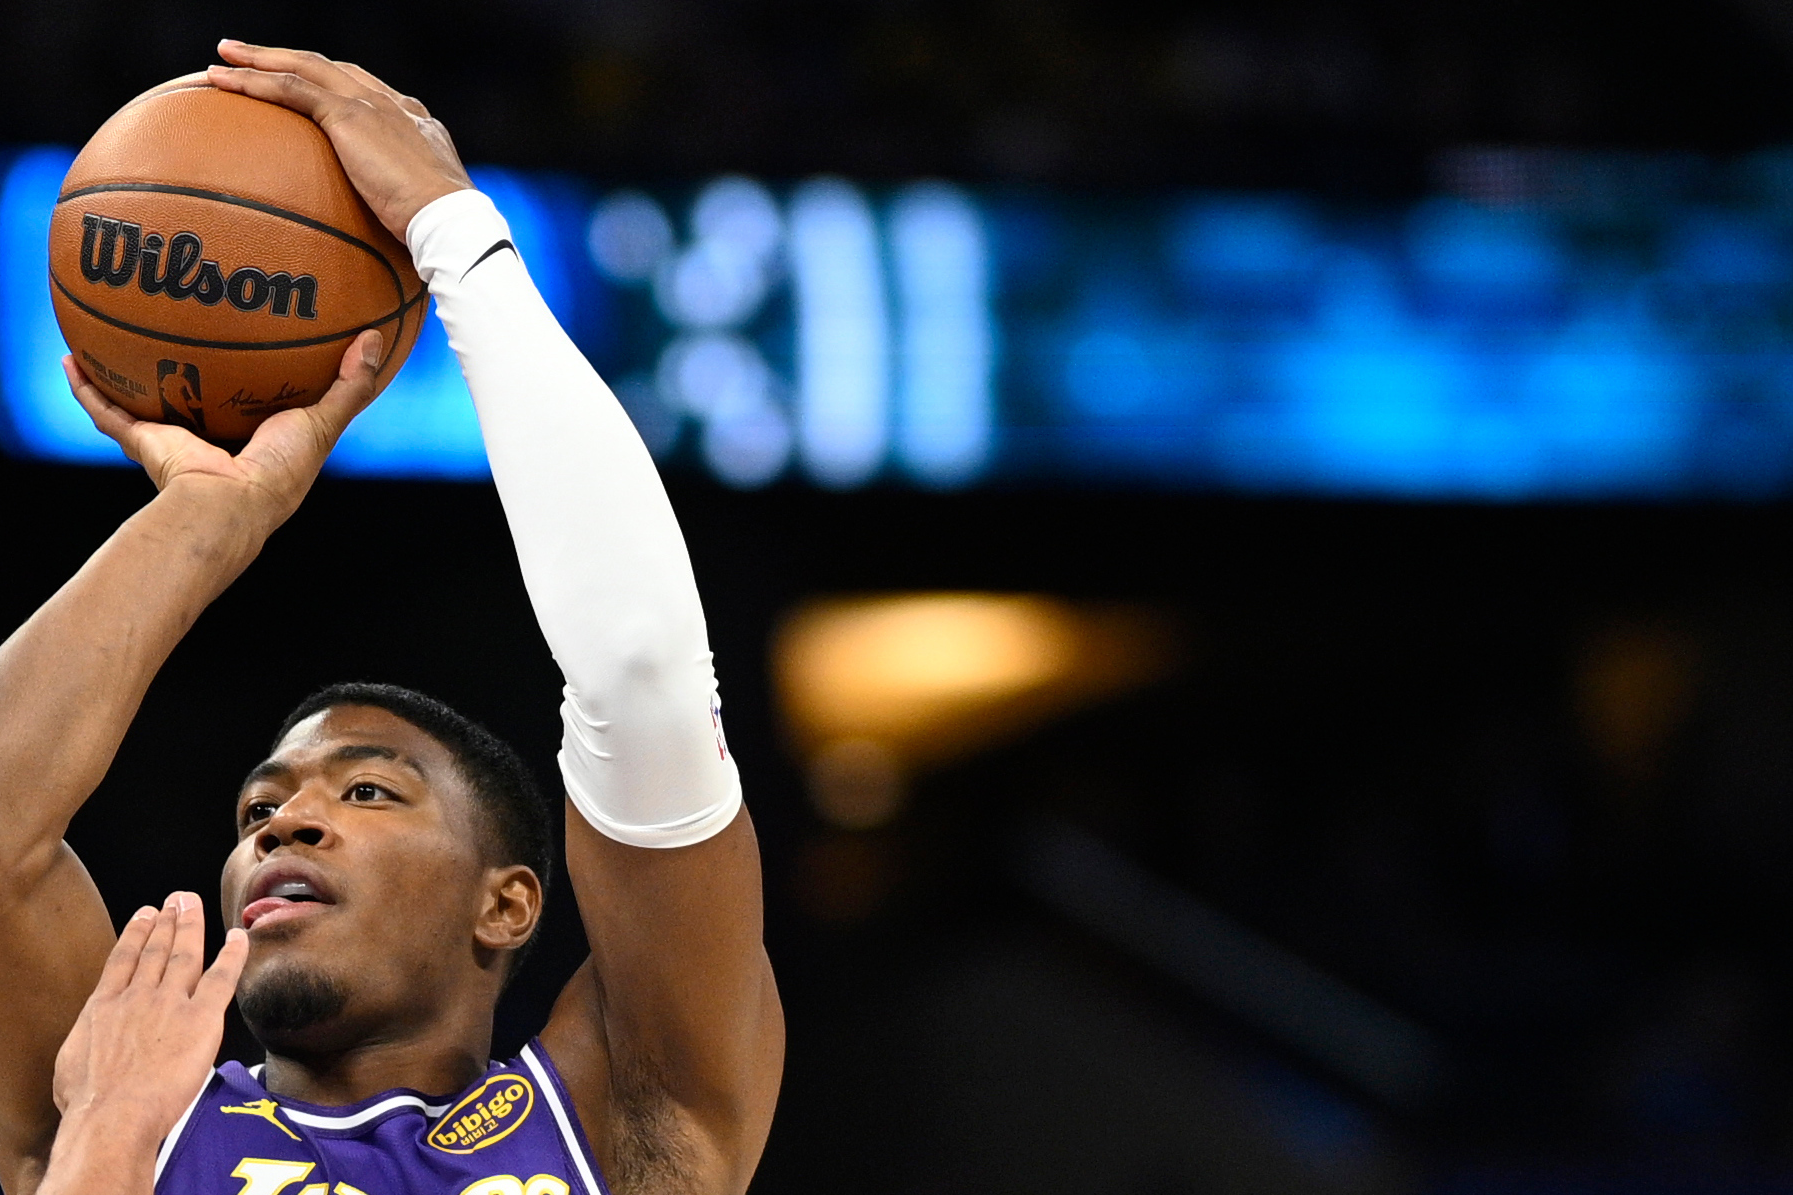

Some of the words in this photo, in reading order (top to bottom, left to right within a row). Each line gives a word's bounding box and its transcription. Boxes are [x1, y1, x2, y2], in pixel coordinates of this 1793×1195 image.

[79, 213, 318, 320] Wilson
[436, 1084, 524, 1146] bibigo
[460, 1118, 499, 1146] 비비고
